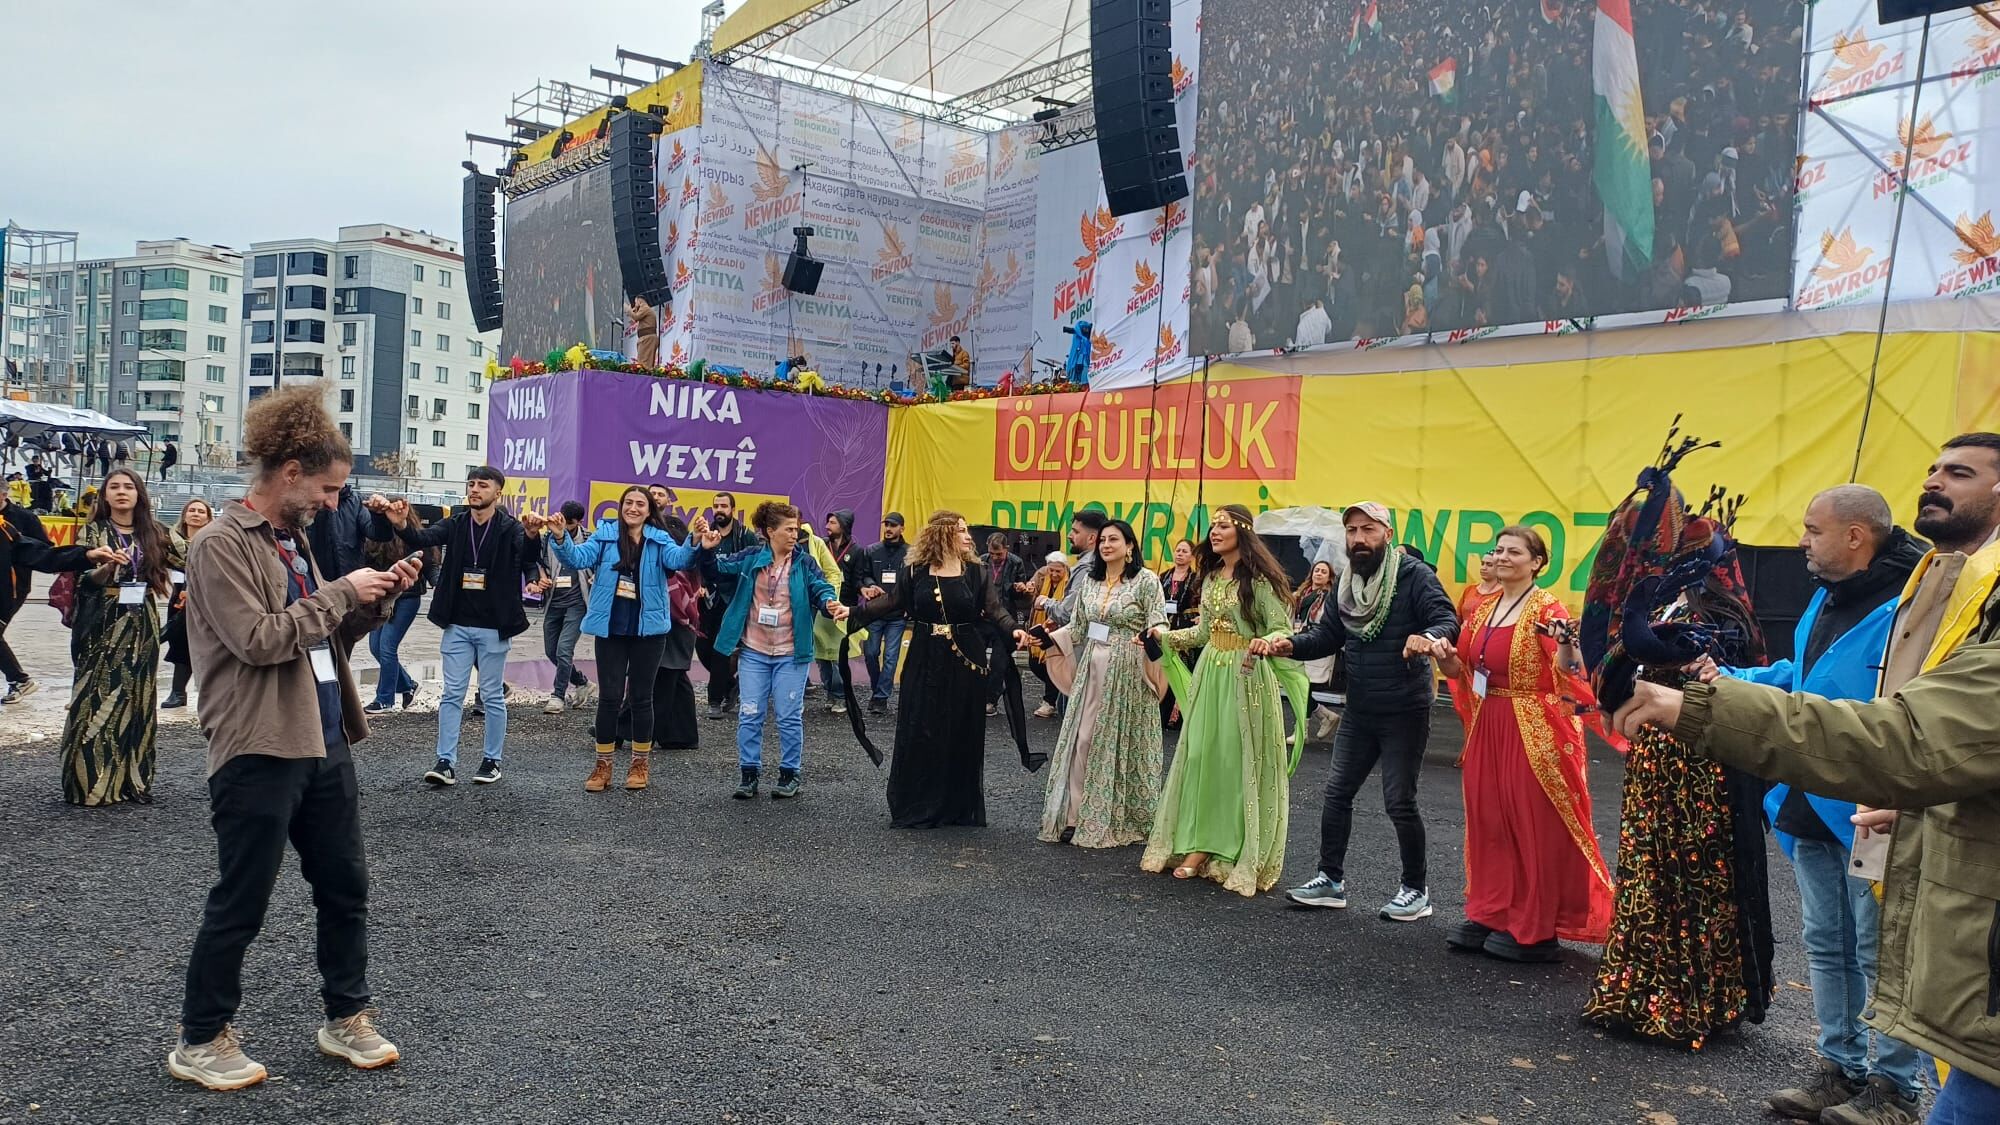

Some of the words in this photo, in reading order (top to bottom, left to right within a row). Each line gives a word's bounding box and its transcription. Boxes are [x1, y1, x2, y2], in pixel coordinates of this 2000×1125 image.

[1810, 52, 1904, 112] NEWROZ
[699, 166, 745, 186] наурыз
[944, 161, 986, 188] NEWROZ
[700, 204, 735, 226] NEWROZ
[744, 192, 801, 230] NEWROZ
[867, 193, 899, 208] наурыз
[919, 225, 971, 244] DEMOKRASİ
[920, 213, 961, 231] ÖZGÜRLÜK
[962, 224, 973, 233] VE
[872, 252, 913, 282] NEWROZ
[1796, 257, 1891, 311] NEWROZ
[1054, 268, 1095, 320] NEW
[921, 317, 969, 352] NEWROZ
[506, 384, 546, 421] NIHA
[650, 382, 742, 425] NIKA
[1008, 385, 1280, 472] ÖZGÜRLÜK
[504, 437, 546, 472] DEMA
[629, 436, 757, 485] WEXTÊ
